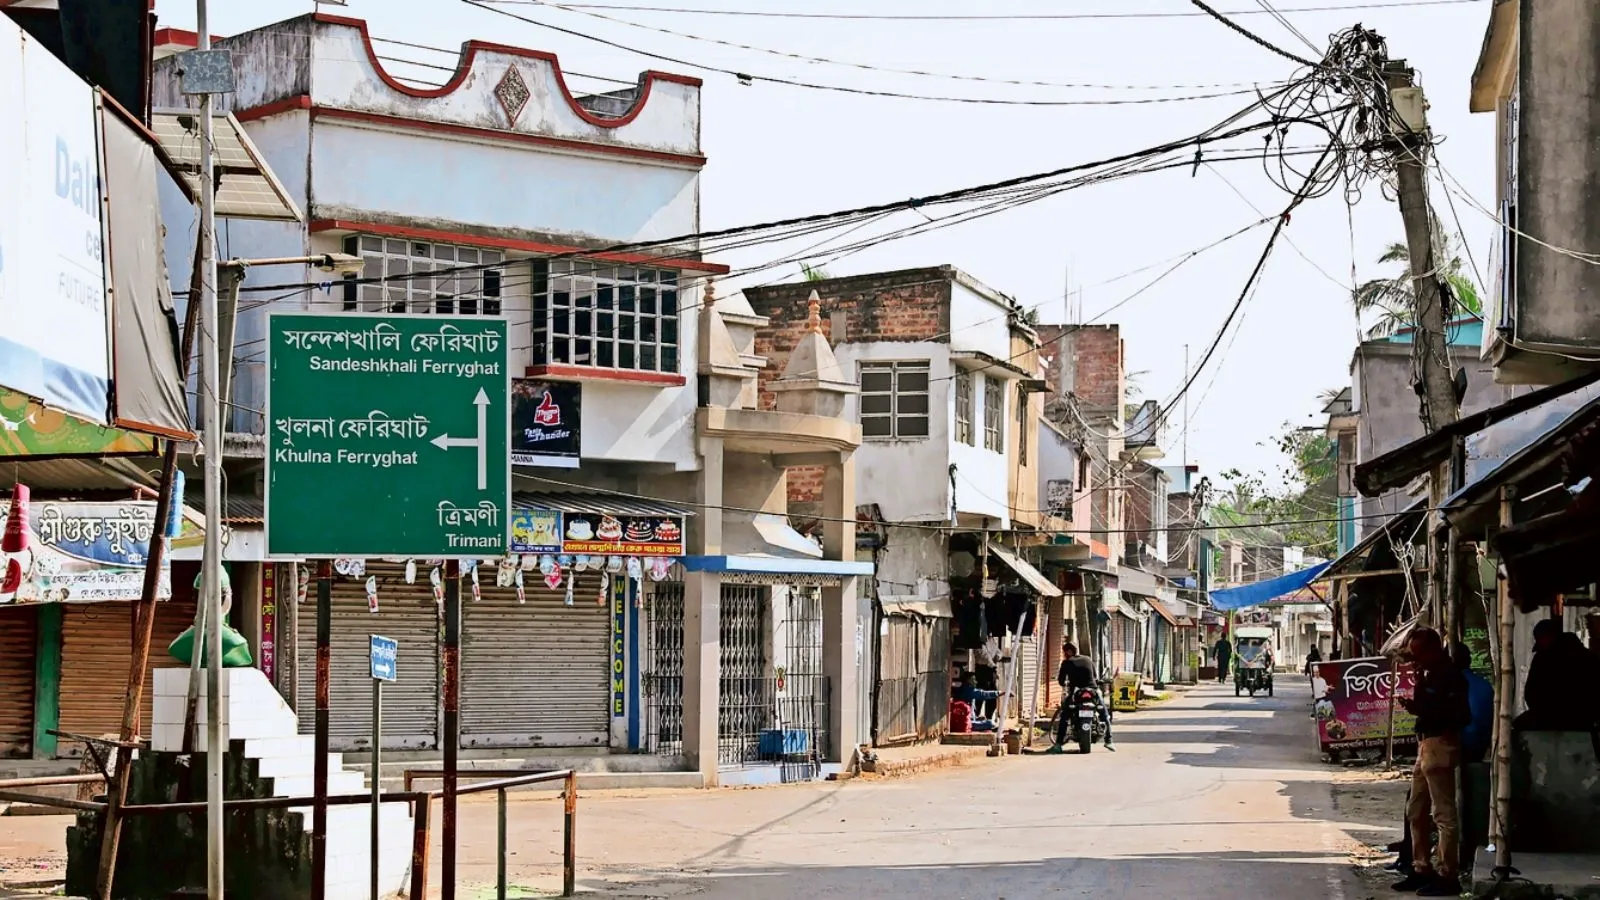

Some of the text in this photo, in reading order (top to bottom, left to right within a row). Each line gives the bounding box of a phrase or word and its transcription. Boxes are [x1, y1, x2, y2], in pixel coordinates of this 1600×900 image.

[57, 271, 100, 313] FUTURE
[282, 322, 502, 353] সন্দেশখালি ফেরিঘাট
[309, 356, 500, 379] Sandeshkhali Ferryghat
[275, 410, 431, 447] খুলনা ফেরিঘাট
[530, 429, 571, 442] Thunder
[275, 449, 418, 468] Khulna Ferryghat
[104, 507, 156, 555] সুইট
[445, 534, 502, 547] Trimani
[614, 580, 625, 713] WELCOME
